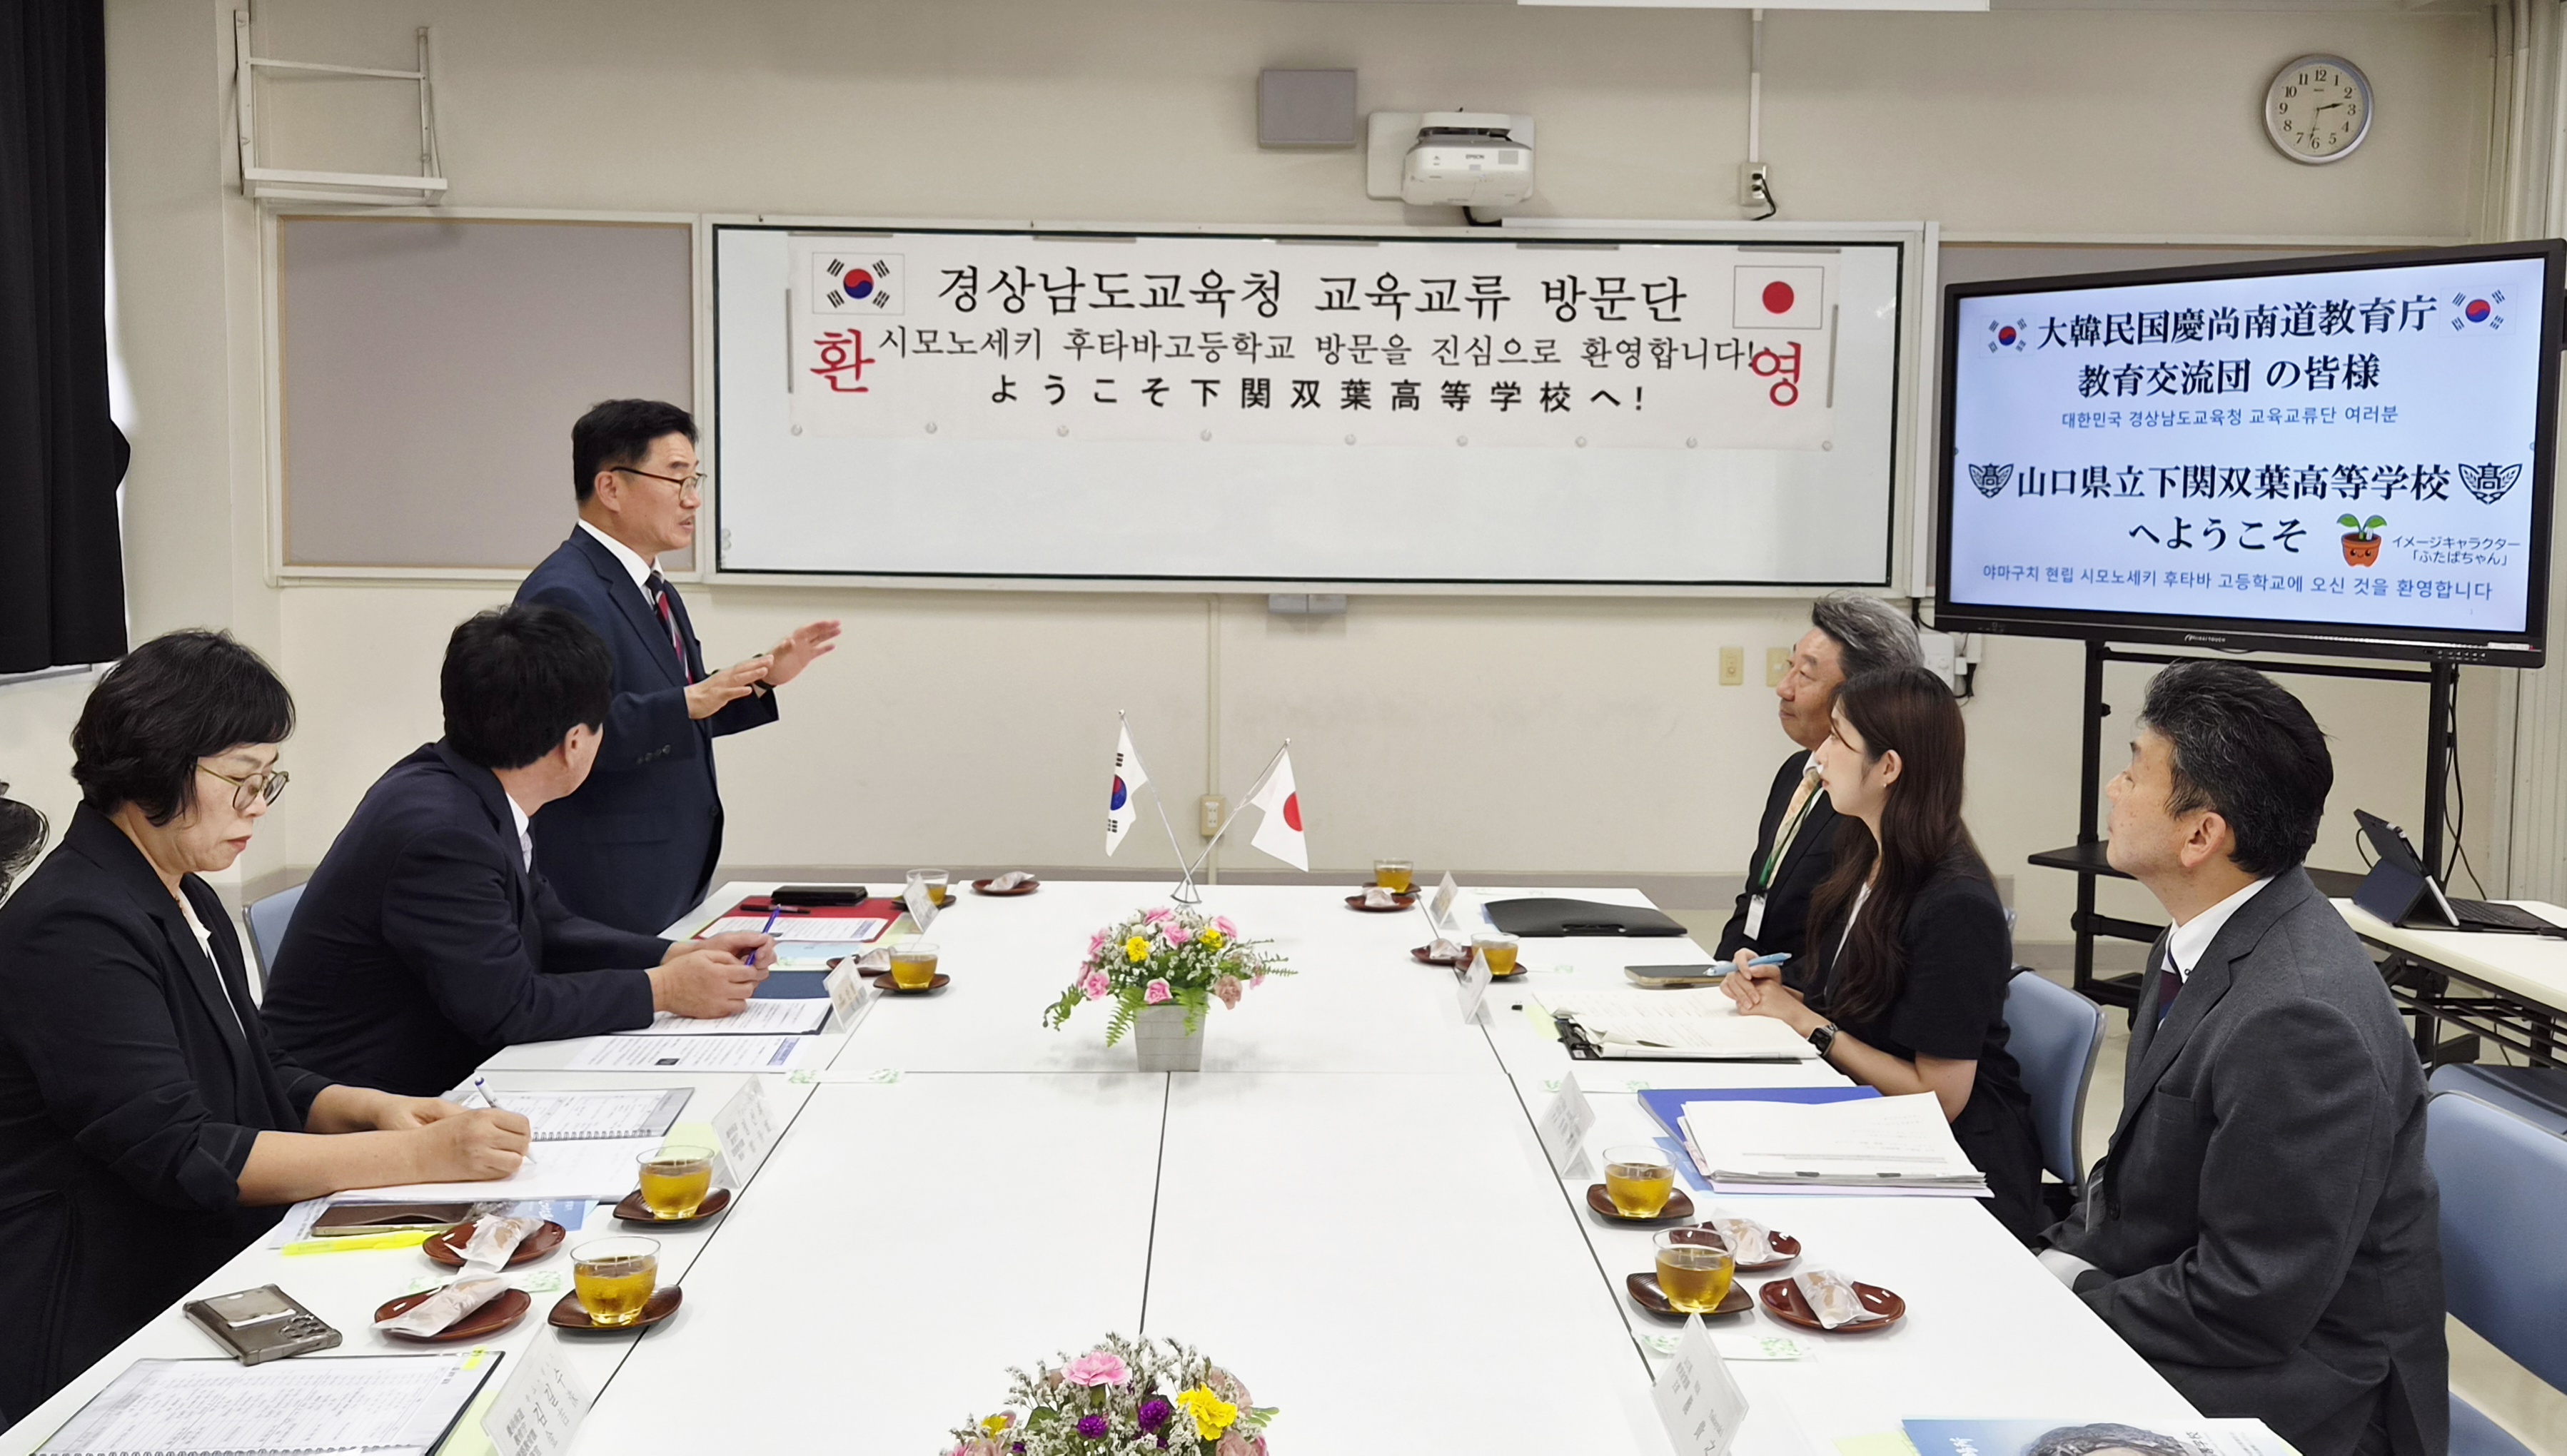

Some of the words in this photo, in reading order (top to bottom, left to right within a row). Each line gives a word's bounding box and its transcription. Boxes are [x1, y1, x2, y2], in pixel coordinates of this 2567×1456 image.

[2299, 74, 2308, 85] 11
[2315, 70, 2326, 81] 12
[2334, 75, 2339, 86] 1
[2285, 86, 2297, 97] 10
[2344, 87, 2352, 98] 2
[2279, 103, 2288, 114] 9
[2348, 104, 2356, 116] 3
[2284, 120, 2291, 131] 8
[2342, 121, 2349, 132] 4
[2296, 133, 2304, 143] 7
[2311, 138, 2319, 149] 6
[2329, 133, 2336, 143] 5
[939, 265, 1280, 319] 경상남도교육청
[1315, 271, 1511, 322] 교육교류
[1540, 274, 1688, 323] 방문단
[2037, 294, 2438, 350] 大韓民国慶尚南道教育庁
[879, 325, 1041, 361] 시모노세키
[1063, 328, 1295, 365] 후타바고등학교
[1315, 333, 1412, 365] 방문을
[1431, 334, 1561, 367] 진심으로
[811, 329, 876, 394] 환
[1751, 343, 1802, 408] 영
[2078, 358, 2251, 398] 教育交流団
[2266, 353, 2380, 392] の皆様
[2062, 411, 2122, 429] 대한민국
[2129, 408, 2241, 428] 경상남도교육청
[2249, 406, 2337, 425] 교육교류단
[2344, 405, 2398, 424] 여러분
[2018, 463, 2451, 501] 山口県立下関双葉高等学校
[2129, 516, 2307, 553] へようこそ
[2392, 536, 2521, 550] イメージキャラクター
[1982, 564, 2039, 582] 야마구치
[2045, 566, 2074, 583] 현립
[2080, 568, 2156, 587] 시모노세키
[2163, 570, 2212, 589] 후타바
[2218, 573, 2303, 592] 고등학교에
[2311, 577, 2344, 595] 오신
[2354, 577, 2389, 596] 것을
[2396, 579, 2493, 601] 환영합니다
